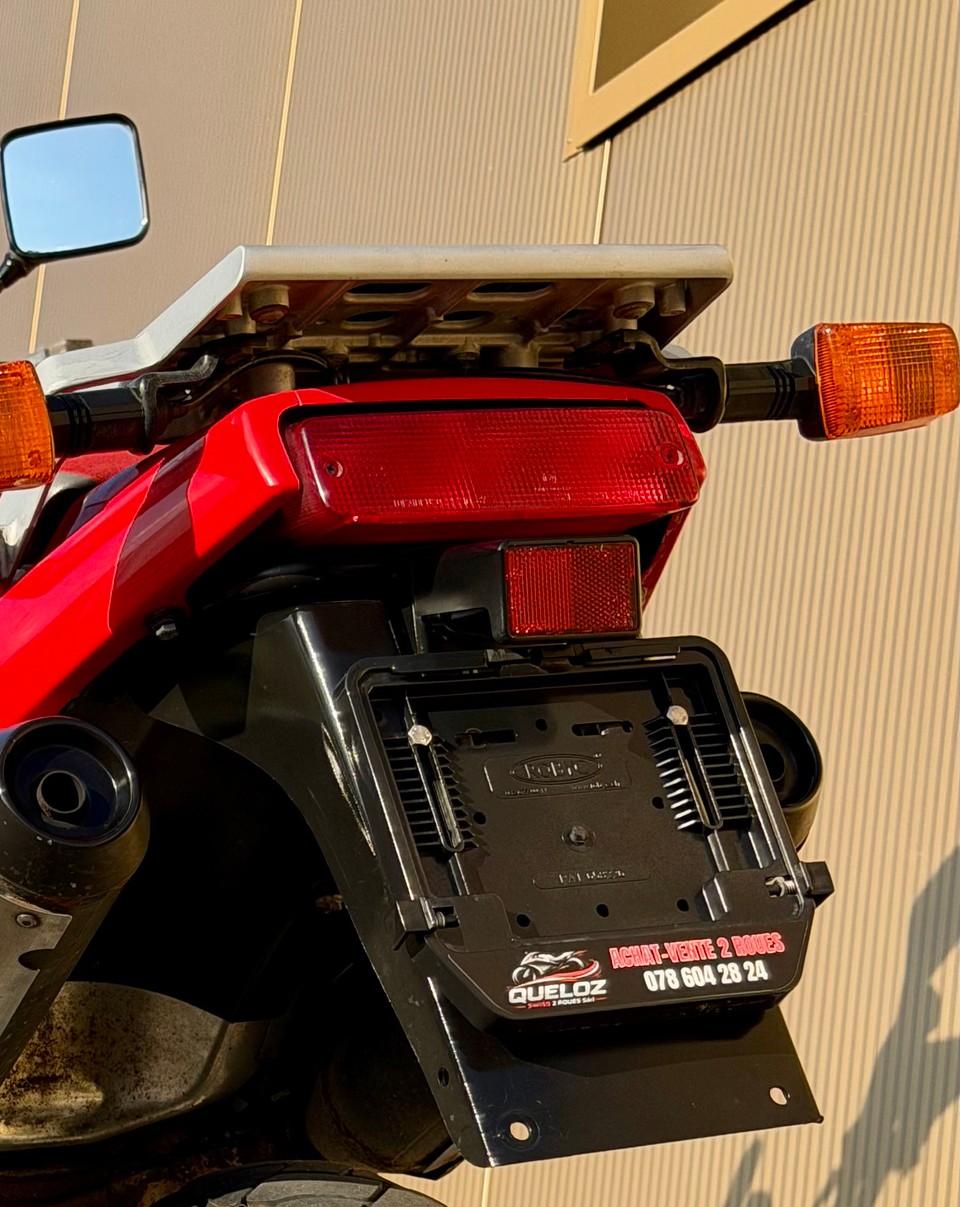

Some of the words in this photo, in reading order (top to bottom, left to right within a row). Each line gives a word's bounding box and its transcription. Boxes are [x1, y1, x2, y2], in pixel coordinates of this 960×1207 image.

[609, 939, 717, 969] ACHAT-VENTE
[716, 937, 732, 959] 2
[731, 932, 785, 957] ROUES
[508, 979, 607, 1004] QUELOZ
[643, 968, 680, 992] 078
[680, 964, 717, 988] 604
[717, 962, 743, 985] 28
[743, 959, 769, 982] 24
